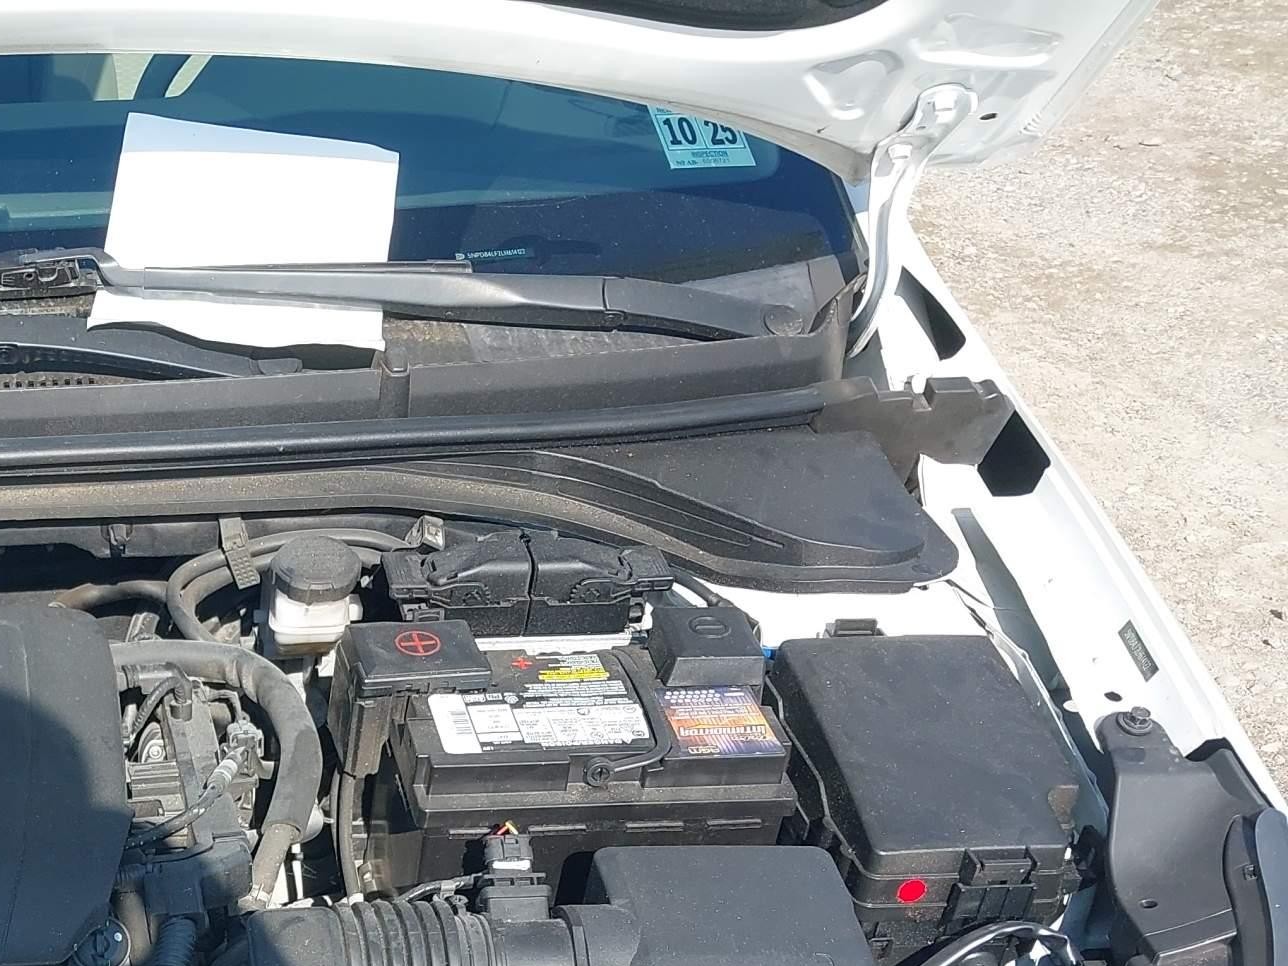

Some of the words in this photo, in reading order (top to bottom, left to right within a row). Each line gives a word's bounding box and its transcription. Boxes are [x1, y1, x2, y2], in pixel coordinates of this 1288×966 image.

[663, 116, 697, 146] 10
[704, 120, 738, 146] 25
[691, 150, 730, 158] INSPECTION
